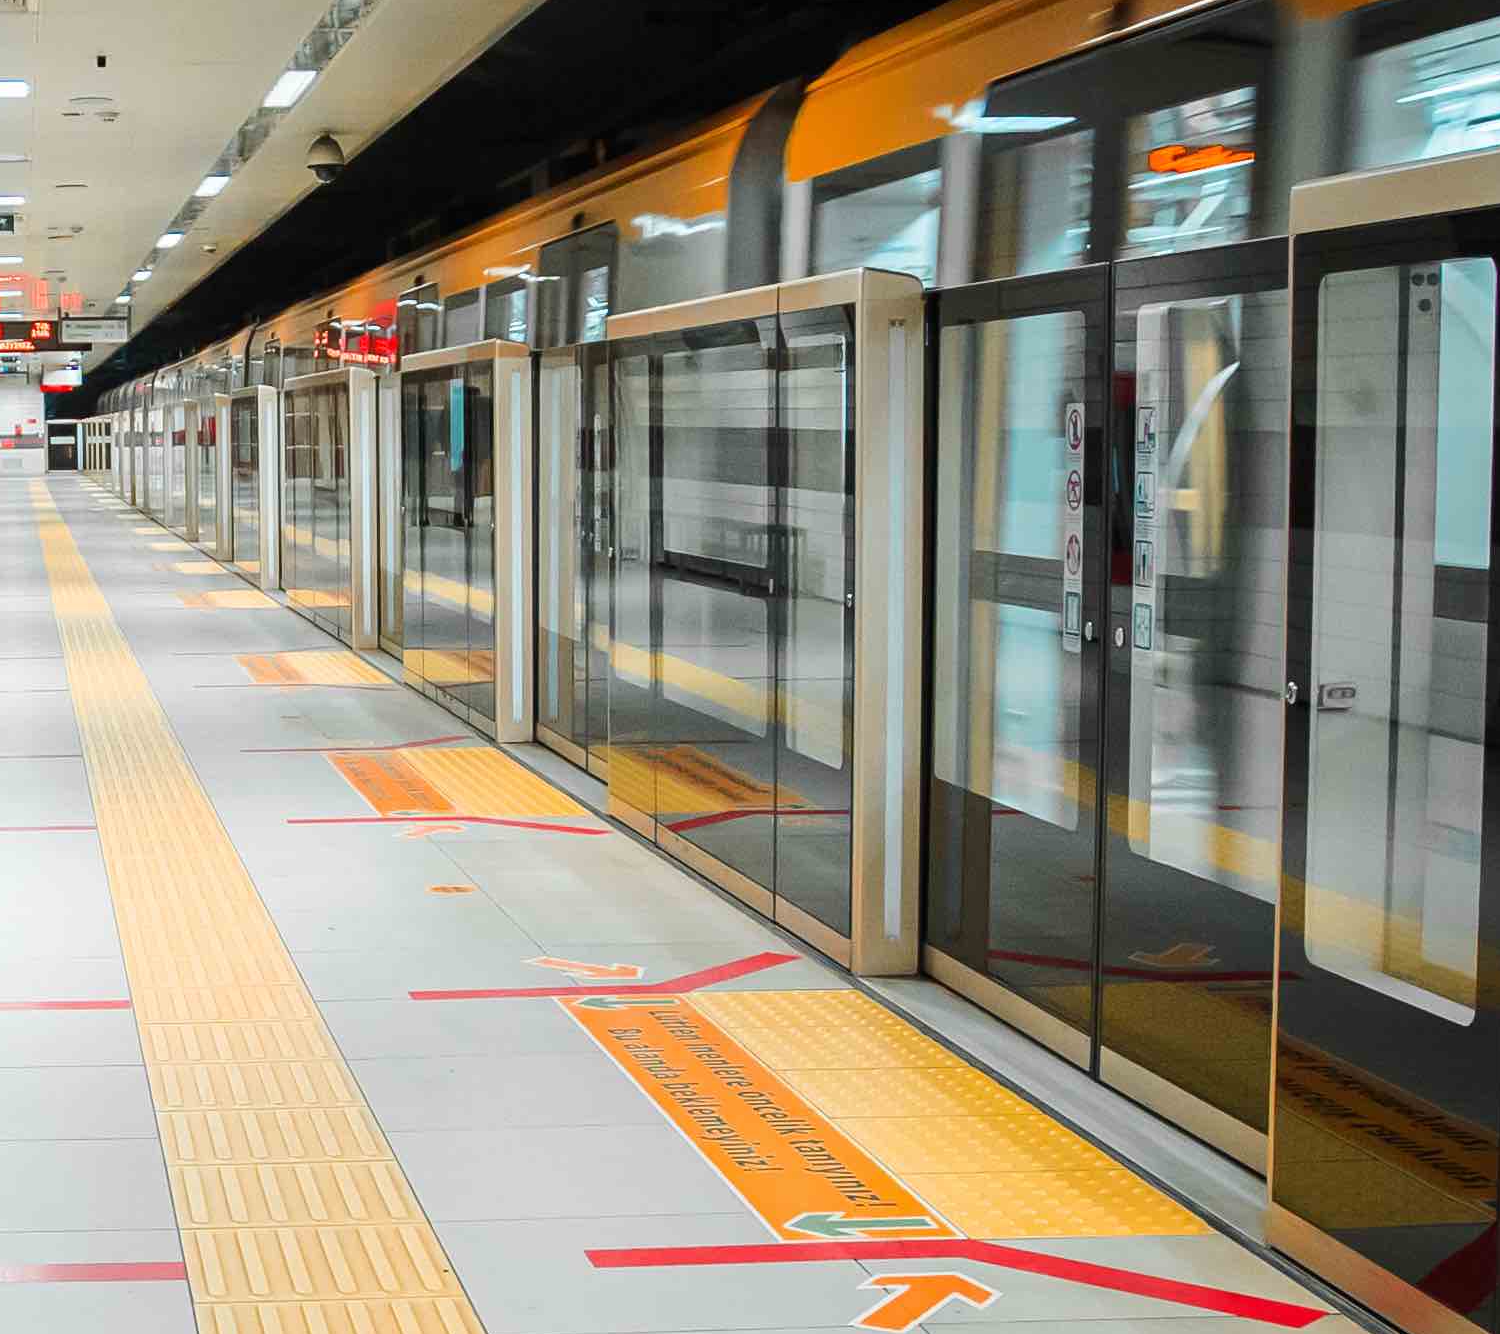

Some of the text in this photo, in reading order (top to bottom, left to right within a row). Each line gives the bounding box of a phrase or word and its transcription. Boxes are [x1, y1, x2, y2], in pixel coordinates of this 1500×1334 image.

[608, 1027, 784, 1171] Bu alanda beklemeyiniz!
[648, 1010, 897, 1207] Lütfen inenlere öncelik tanıyınız!
